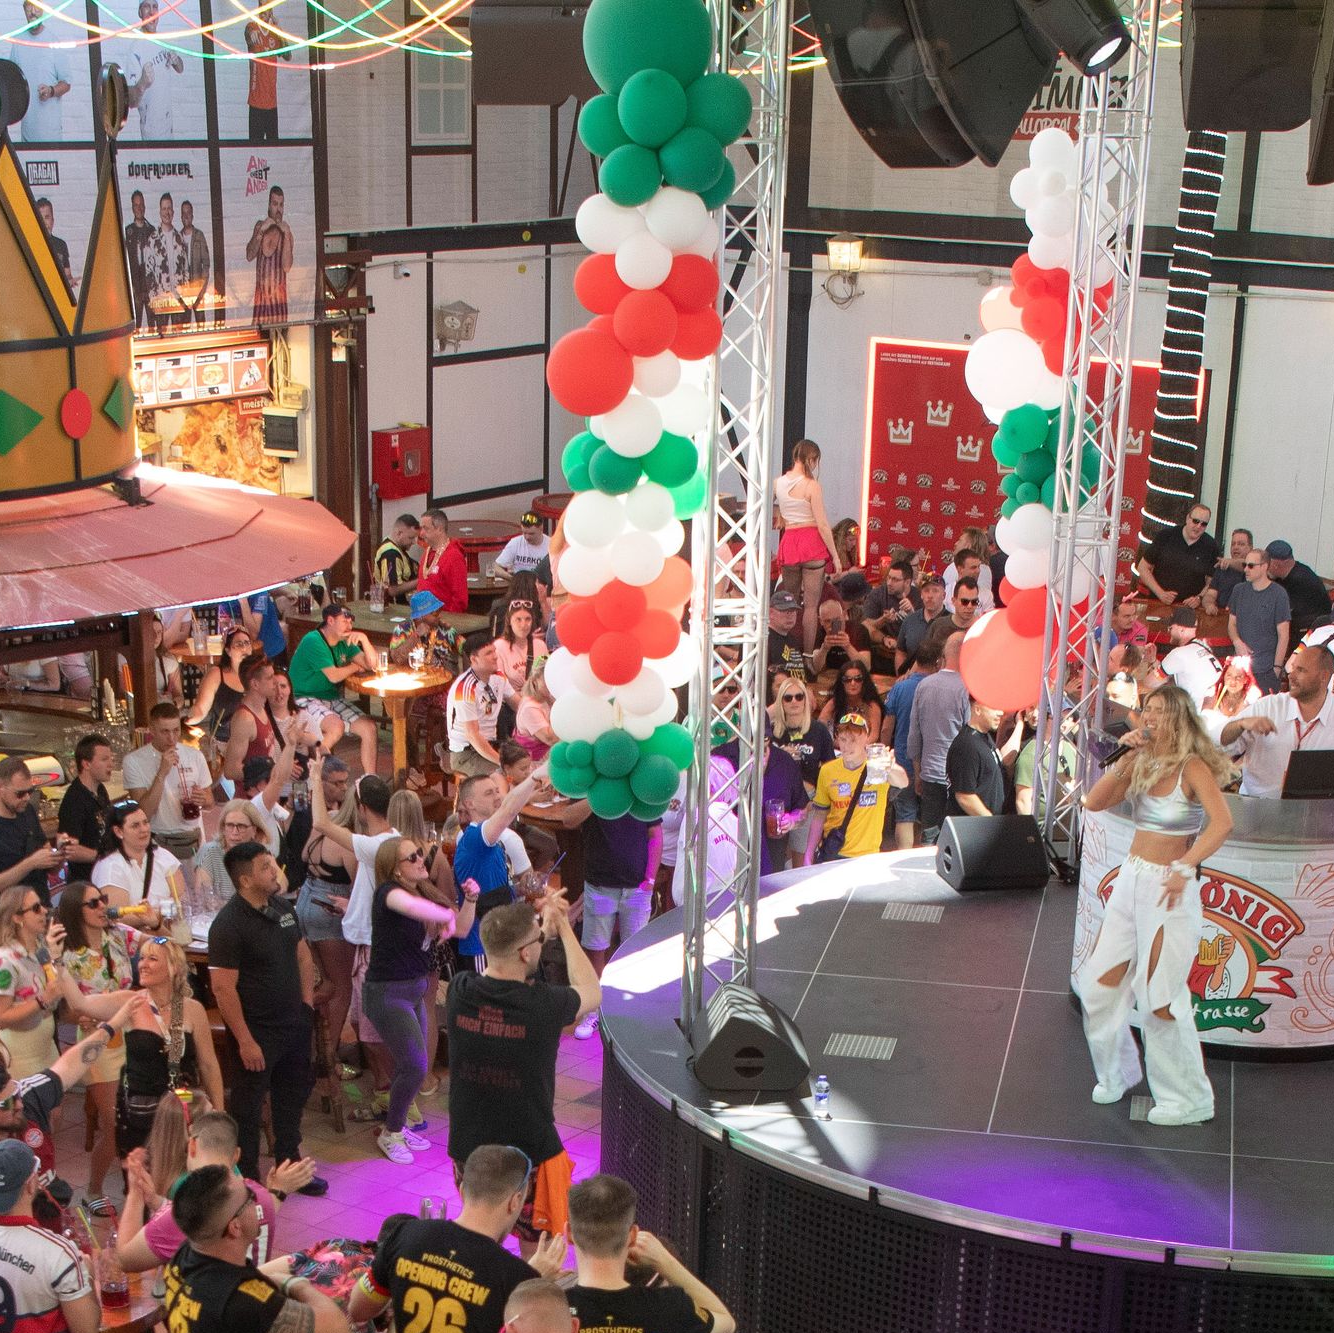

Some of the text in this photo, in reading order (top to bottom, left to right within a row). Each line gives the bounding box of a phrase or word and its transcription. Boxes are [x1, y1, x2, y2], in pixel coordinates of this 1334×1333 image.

[396, 1258, 447, 1293] OPENING
[447, 1276, 491, 1307] CREW
[421, 1252, 476, 1280] PROSTHETICS
